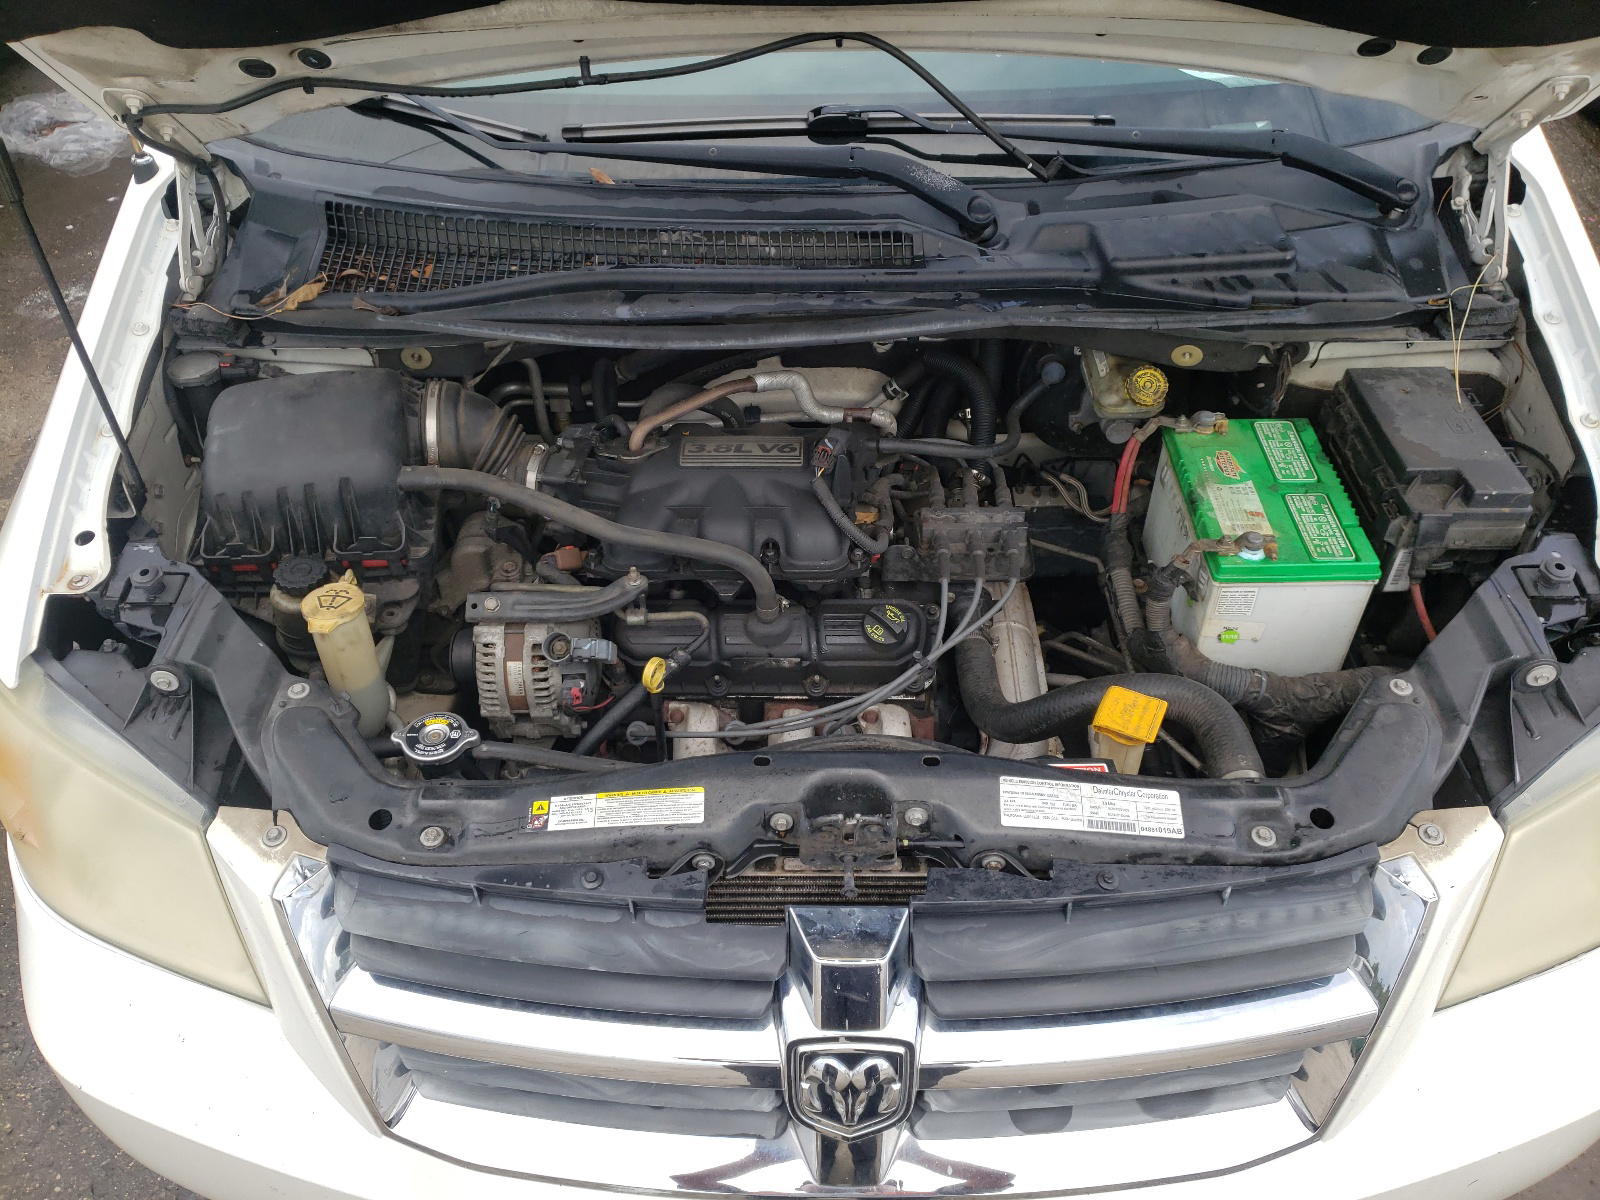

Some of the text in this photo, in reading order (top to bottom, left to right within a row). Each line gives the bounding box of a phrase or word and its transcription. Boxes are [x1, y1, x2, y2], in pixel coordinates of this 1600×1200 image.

[688, 443, 798, 454] 3.8L V6
[1092, 785, 1169, 800] DaimlerChrysler Corporation
